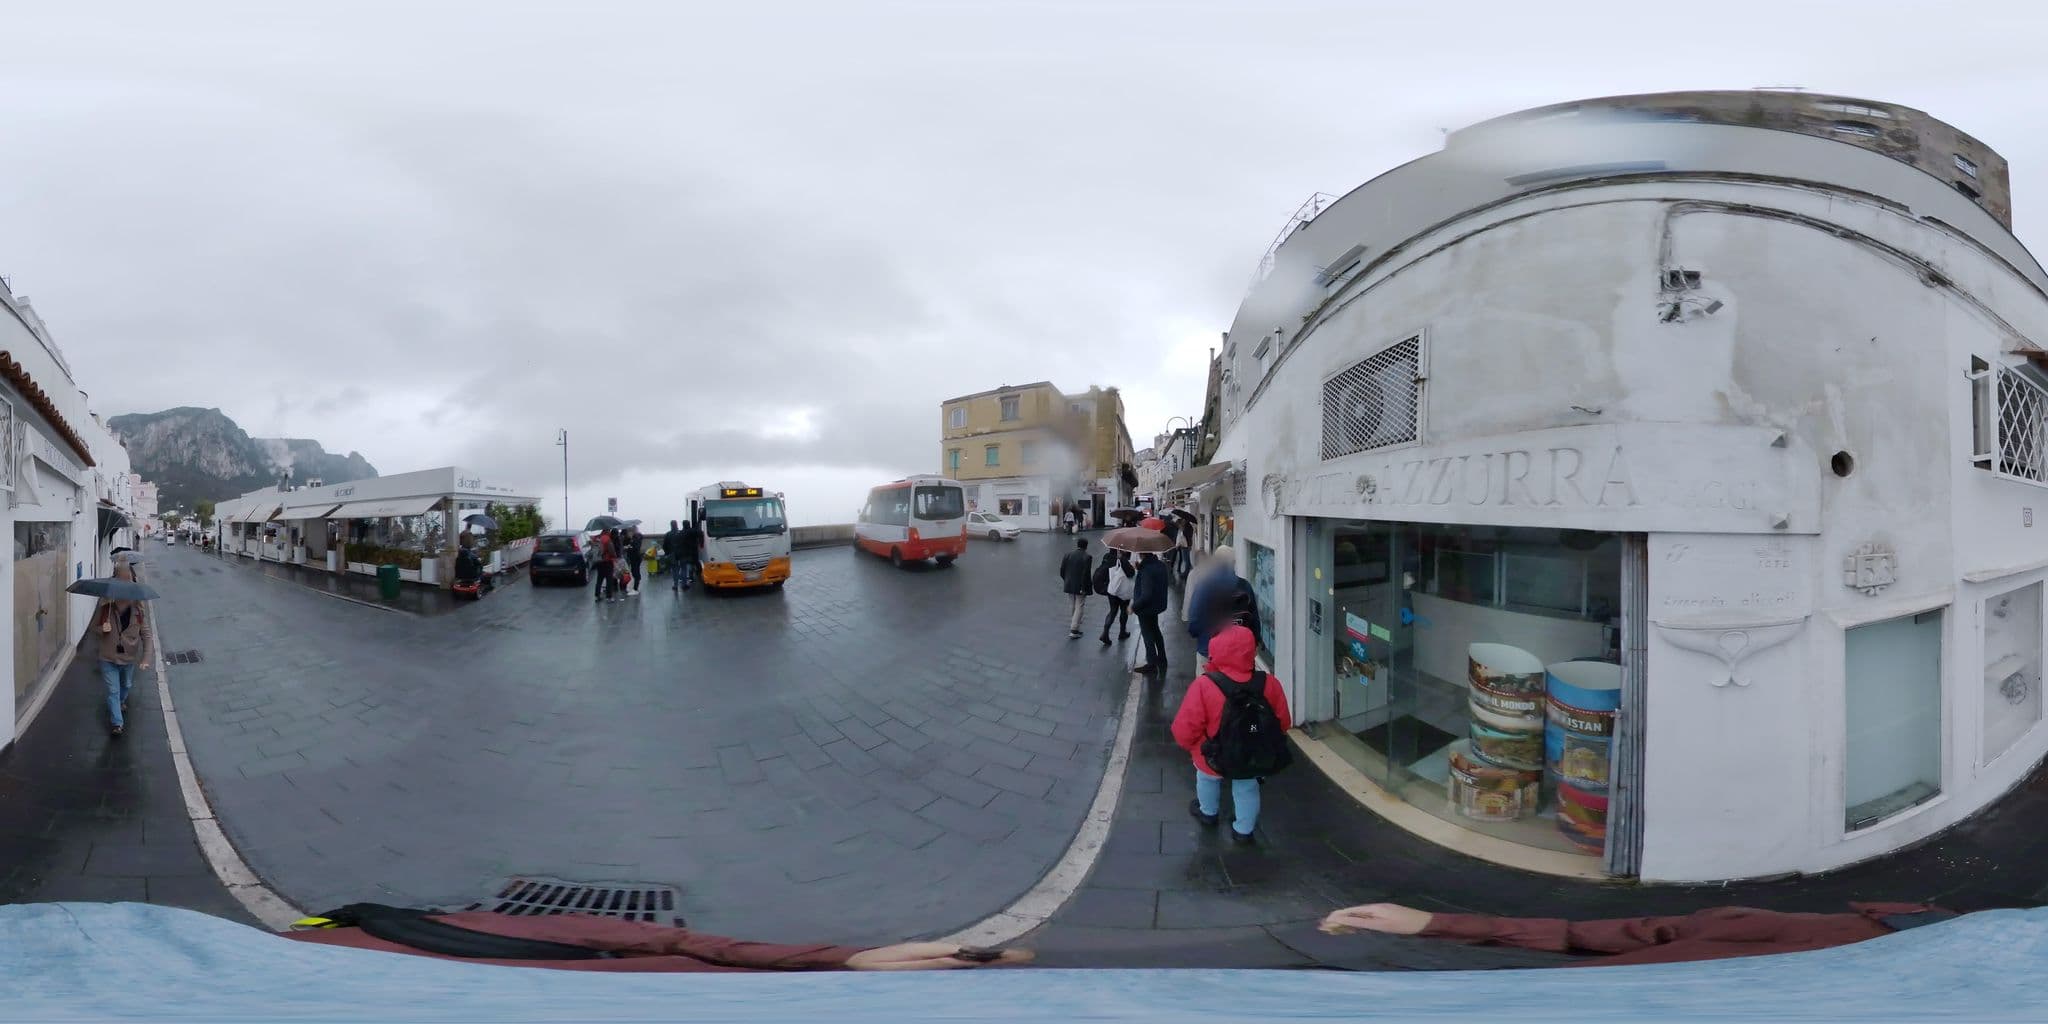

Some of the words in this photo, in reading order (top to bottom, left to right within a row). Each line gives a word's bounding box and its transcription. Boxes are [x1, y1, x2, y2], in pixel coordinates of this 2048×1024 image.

[1374, 446, 1642, 508] AZZURRA
[1501, 700, 1536, 712] MONDO
[1567, 717, 1602, 732] ISTAN
